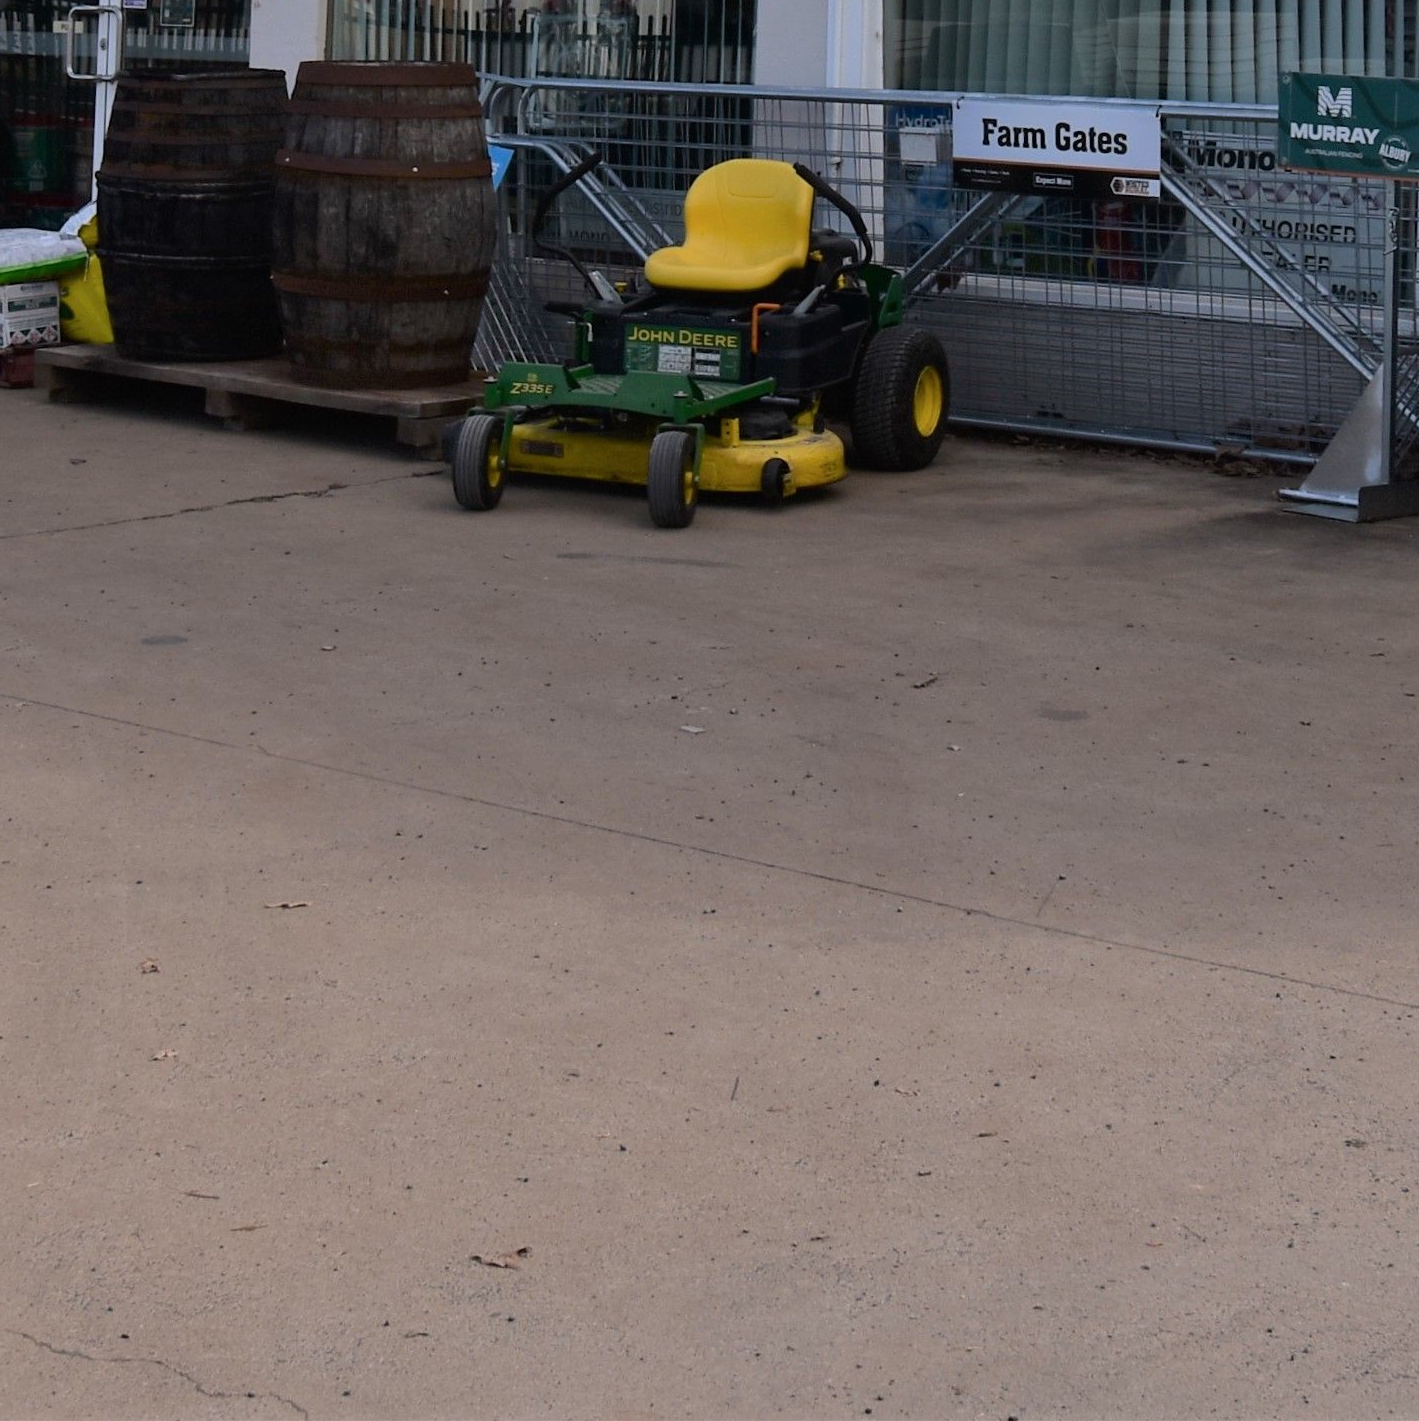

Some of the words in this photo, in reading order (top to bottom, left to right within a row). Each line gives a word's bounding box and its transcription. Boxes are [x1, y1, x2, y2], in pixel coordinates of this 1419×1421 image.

[981, 117, 1047, 149] Farm
[1054, 121, 1129, 155] Gates
[1290, 121, 1380, 145] MURRAY
[1379, 142, 1412, 163] ALBURY
[1219, 211, 1357, 244] UHORISED
[628, 325, 675, 344] JOHN
[679, 328, 738, 349] DEERE
[509, 381, 555, 396] Z335E
